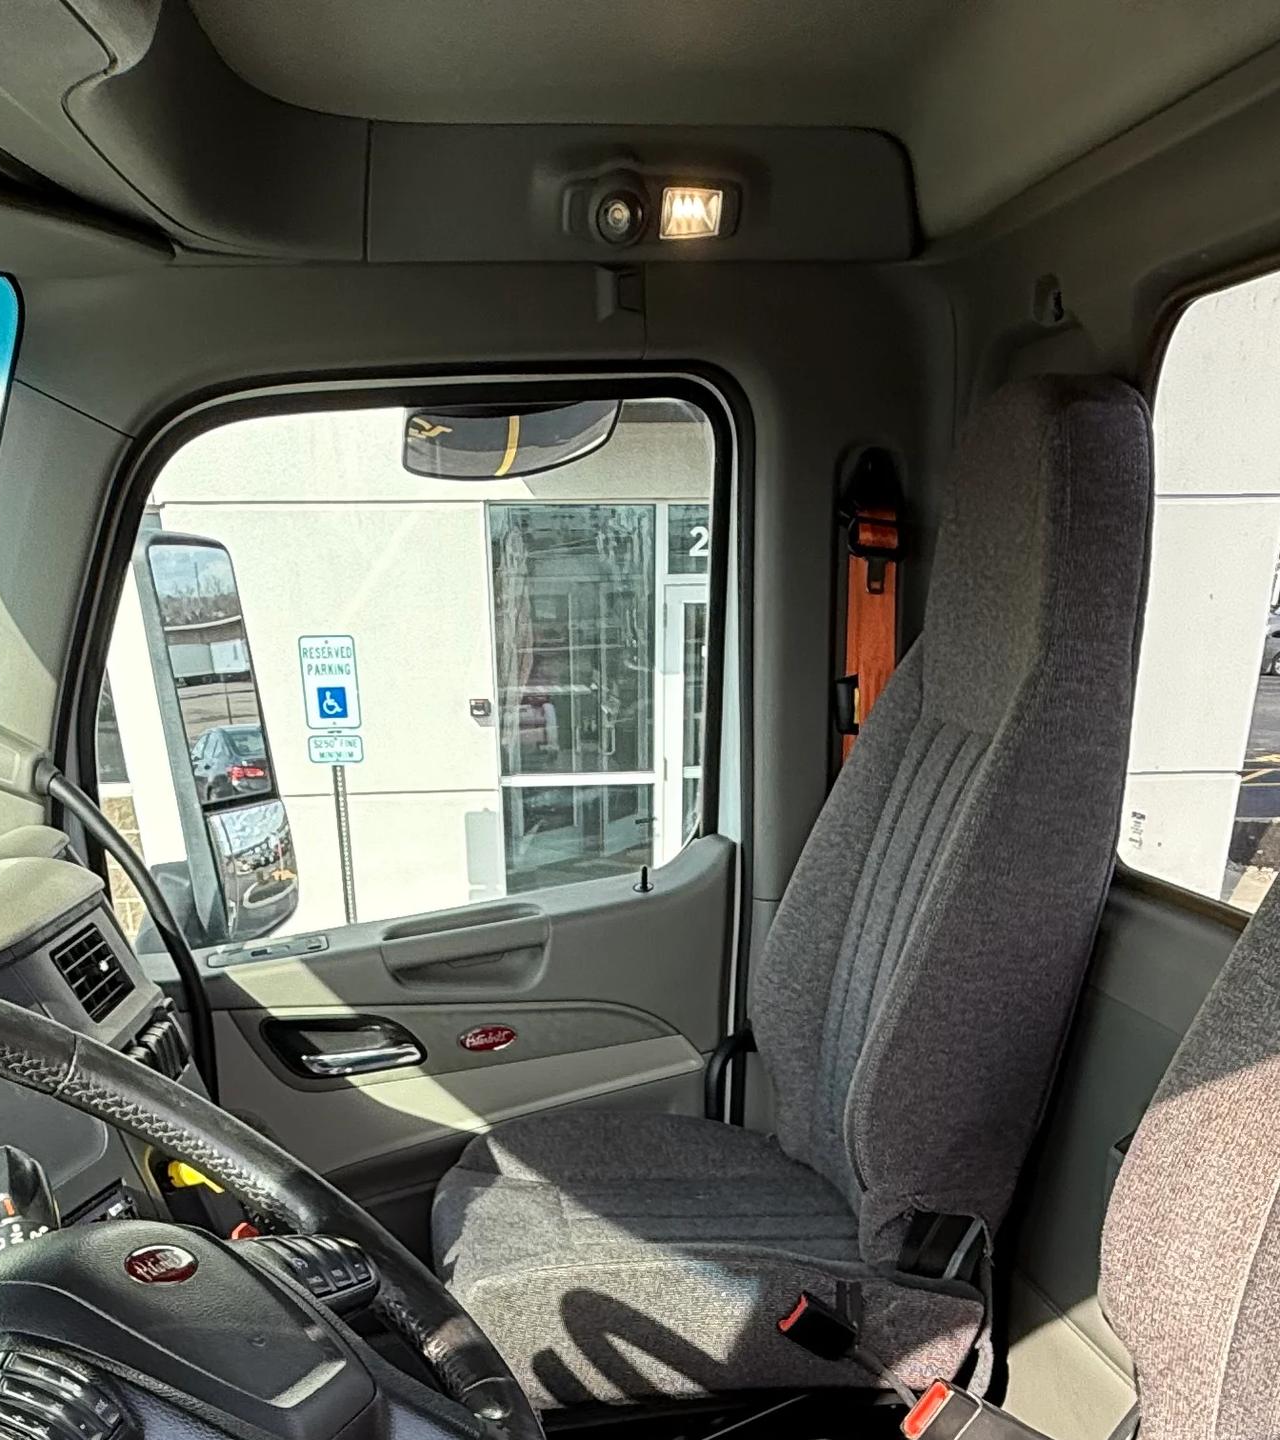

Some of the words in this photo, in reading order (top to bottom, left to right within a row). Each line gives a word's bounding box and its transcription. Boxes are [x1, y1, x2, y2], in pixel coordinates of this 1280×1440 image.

[689, 526, 708, 556] 2
[302, 647, 352, 659] RESERVED
[307, 663, 351, 676] PARKING
